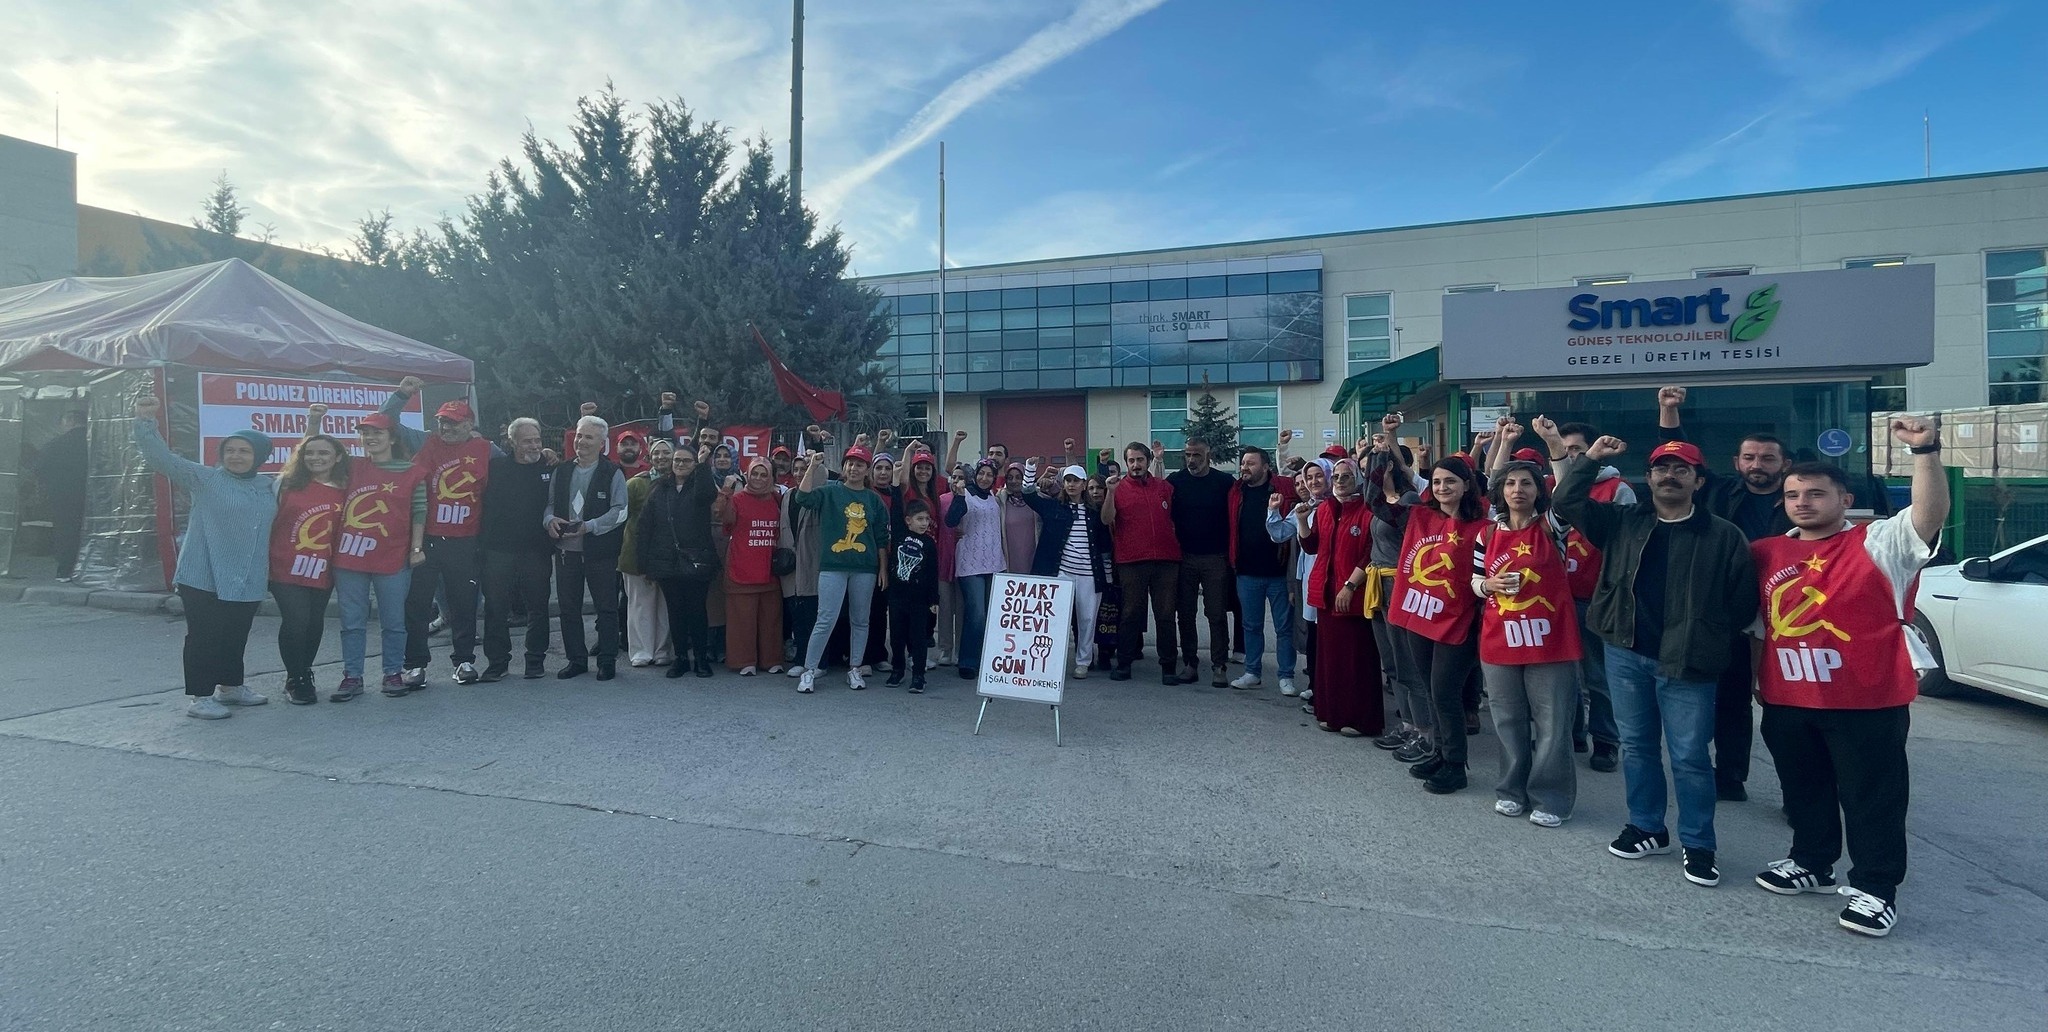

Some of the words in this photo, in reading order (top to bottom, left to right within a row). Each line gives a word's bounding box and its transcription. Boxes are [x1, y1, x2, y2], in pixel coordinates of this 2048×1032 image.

[1139, 312, 1168, 324] think.
[1172, 310, 1210, 321] SMART
[1568, 287, 1730, 331] Smart
[1149, 323, 1169, 333] act.
[1172, 321, 1211, 332] SOLAR
[1567, 335, 1613, 347] GÜNEŞ
[1617, 329, 1728, 345] TEKNOLOJİLERİ
[1567, 354, 1623, 366] GEBZE
[1645, 350, 1711, 362] ÜRETİM
[1721, 346, 1781, 360] TESİSİ
[236, 381, 305, 402] POLONEZ
[251, 411, 309, 434] SMAR
[437, 501, 471, 525] DİP
[339, 531, 378, 558] DİP
[290, 553, 328, 580] DİP
[1004, 580, 1060, 600] SMART
[1001, 597, 1056, 617] SOLAR
[1401, 587, 1445, 621] DİP
[1503, 614, 1551, 648] DİP
[992, 655, 1026, 675] GÜN
[1776, 641, 1843, 683] DİP
[1012, 676, 1032, 686] GREV
